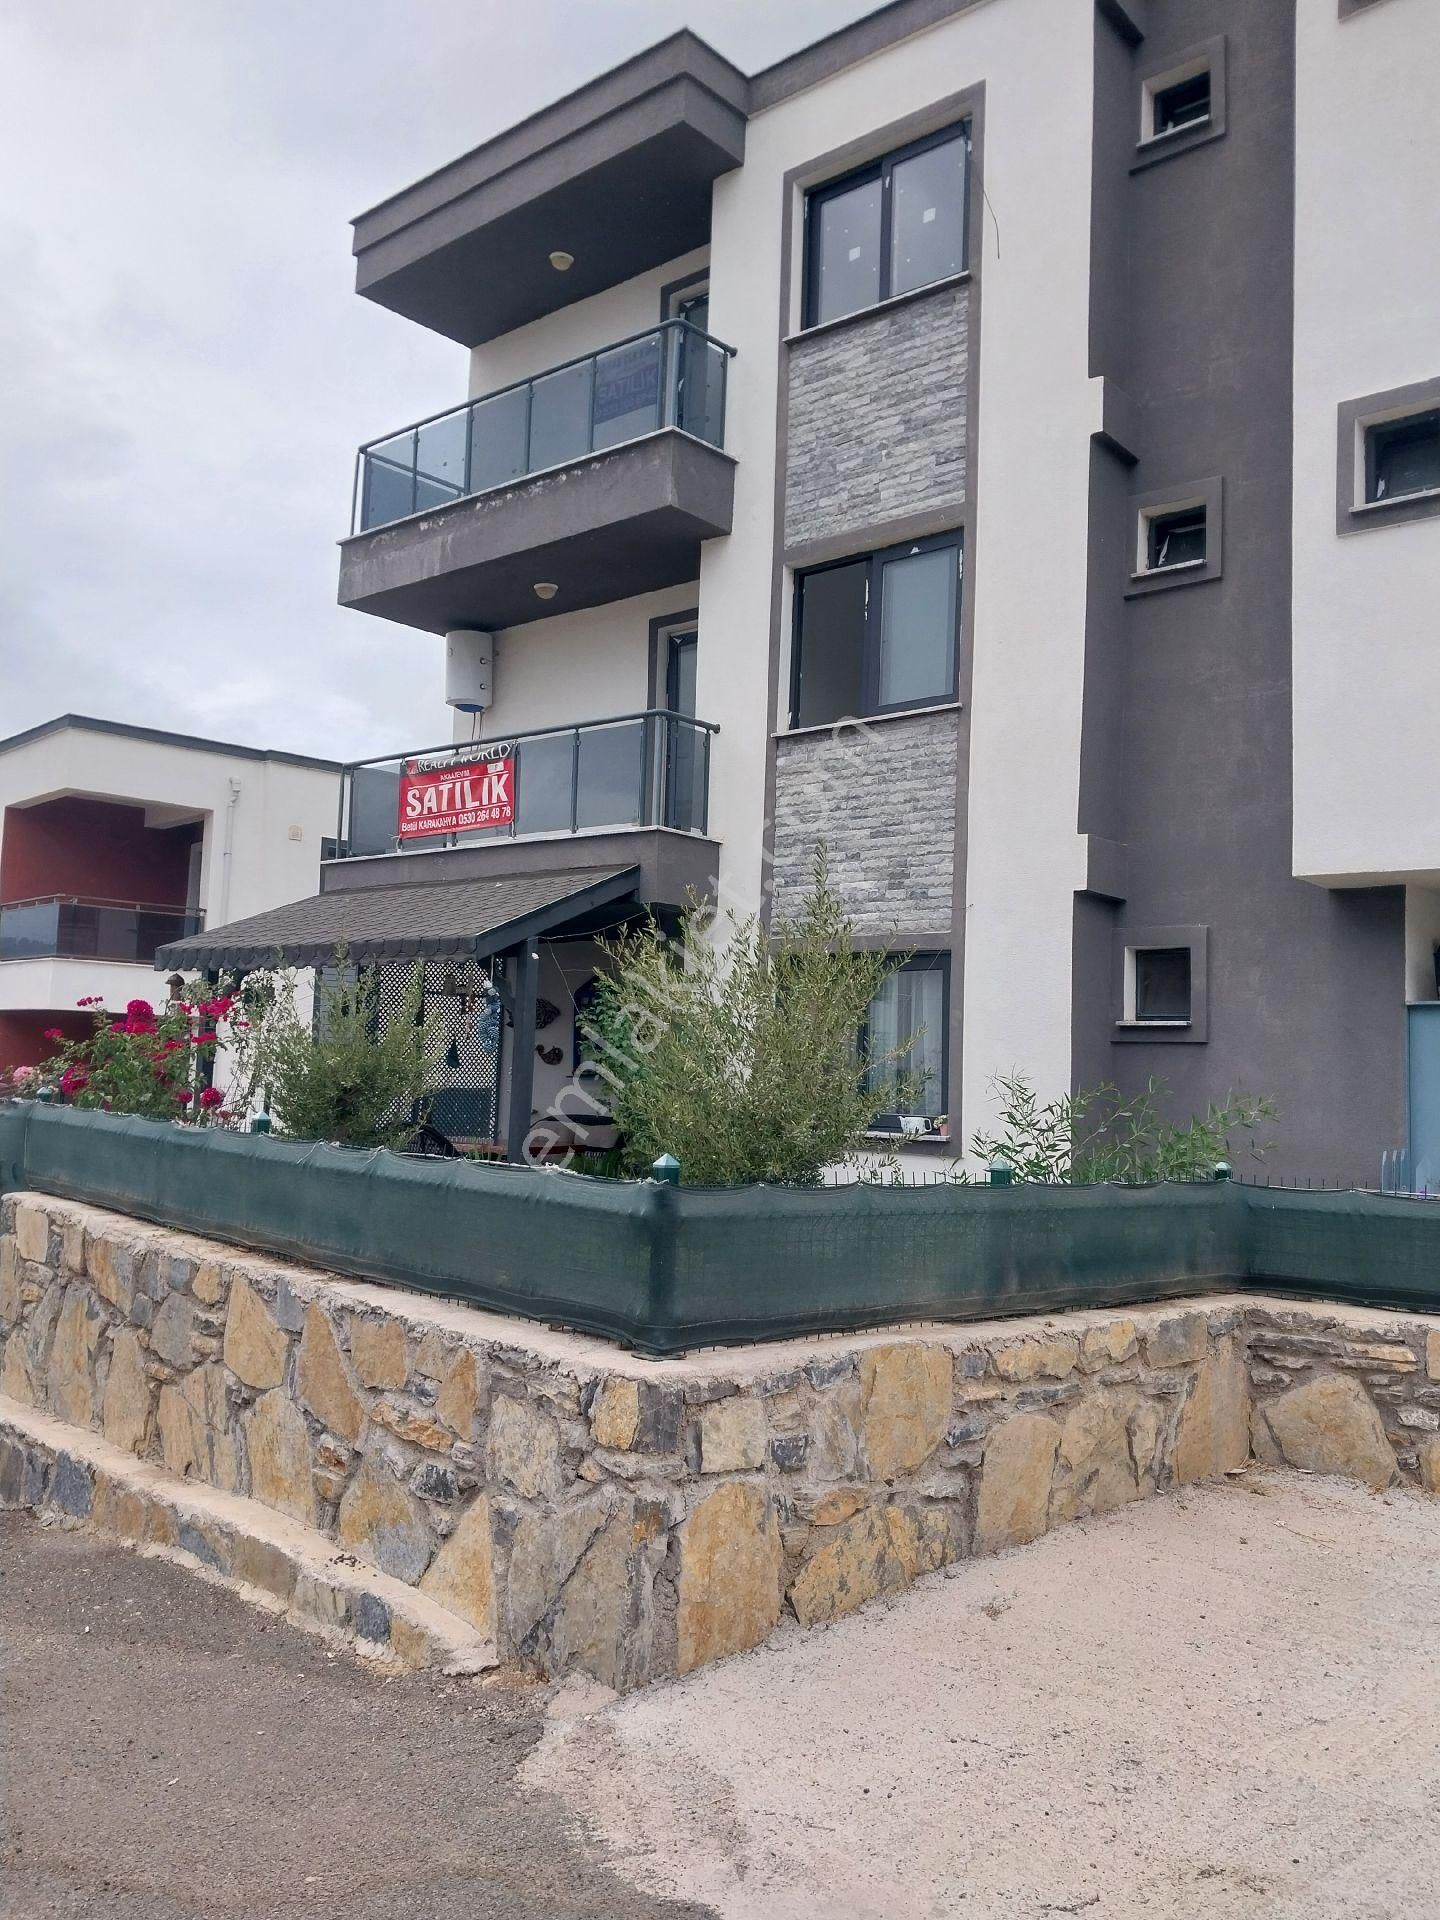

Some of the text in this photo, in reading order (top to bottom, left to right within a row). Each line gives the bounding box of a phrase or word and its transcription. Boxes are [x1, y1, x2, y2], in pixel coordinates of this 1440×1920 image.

[406, 774, 509, 816] SATILIK
[458, 812, 476, 825] 0530
[477, 809, 489, 822] 264
[502, 806, 511, 817] 78
